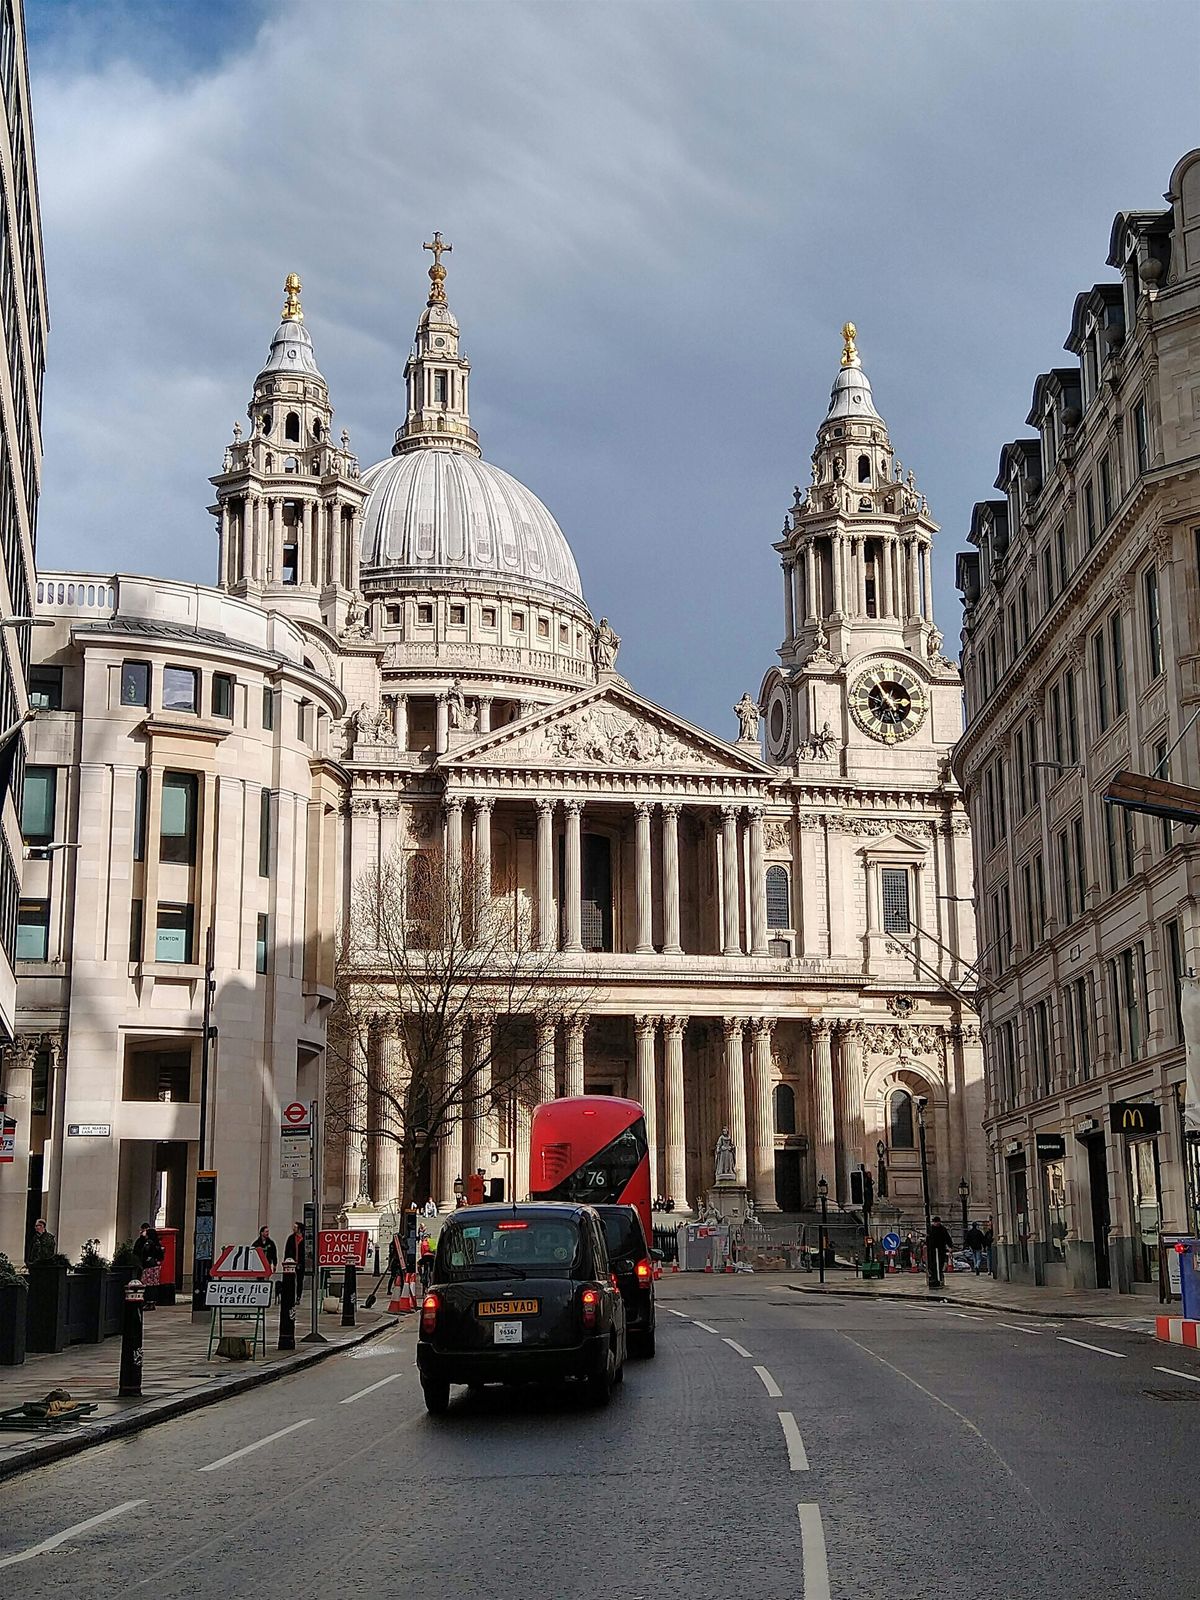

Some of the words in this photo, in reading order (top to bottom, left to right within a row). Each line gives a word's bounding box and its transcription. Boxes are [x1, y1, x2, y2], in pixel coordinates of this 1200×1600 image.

[588, 1171, 605, 1185] 76
[324, 1233, 361, 1243] CYCLE
[327, 1244, 355, 1253] LANE
[319, 1254, 362, 1264] CLOSD
[209, 1284, 245, 1296] Single
[250, 1284, 269, 1295] file
[219, 1295, 257, 1304] traffic
[482, 1302, 510, 1314] LN59
